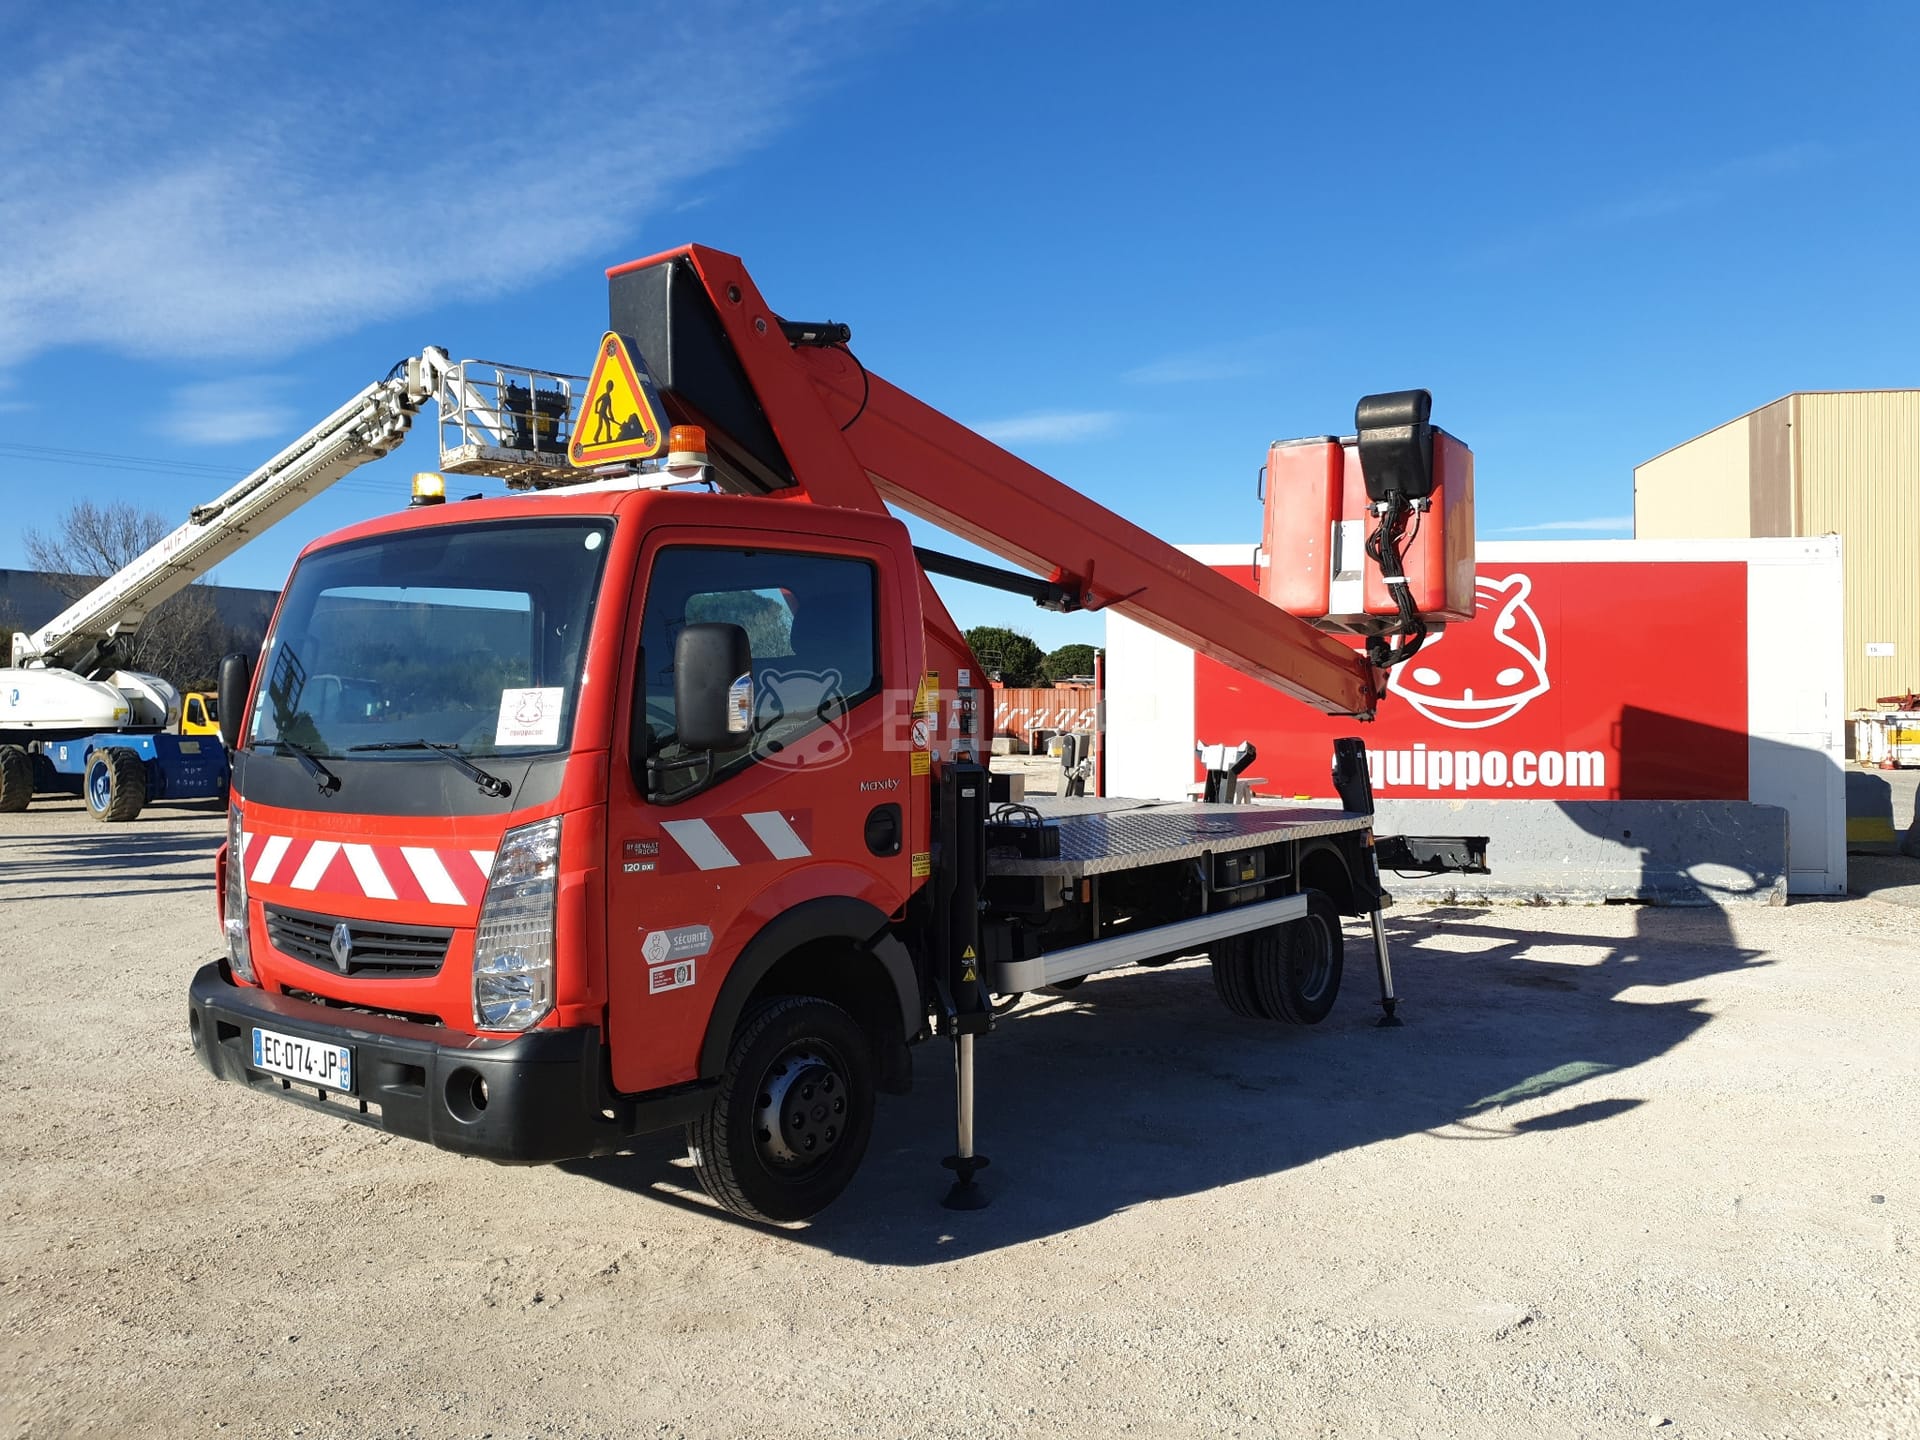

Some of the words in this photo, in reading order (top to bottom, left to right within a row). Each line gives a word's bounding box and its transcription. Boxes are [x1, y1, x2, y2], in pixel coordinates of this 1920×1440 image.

[1332, 743, 1605, 790] quippo.com
[860, 778, 901, 792] Maxity
[623, 863, 640, 872] 120
